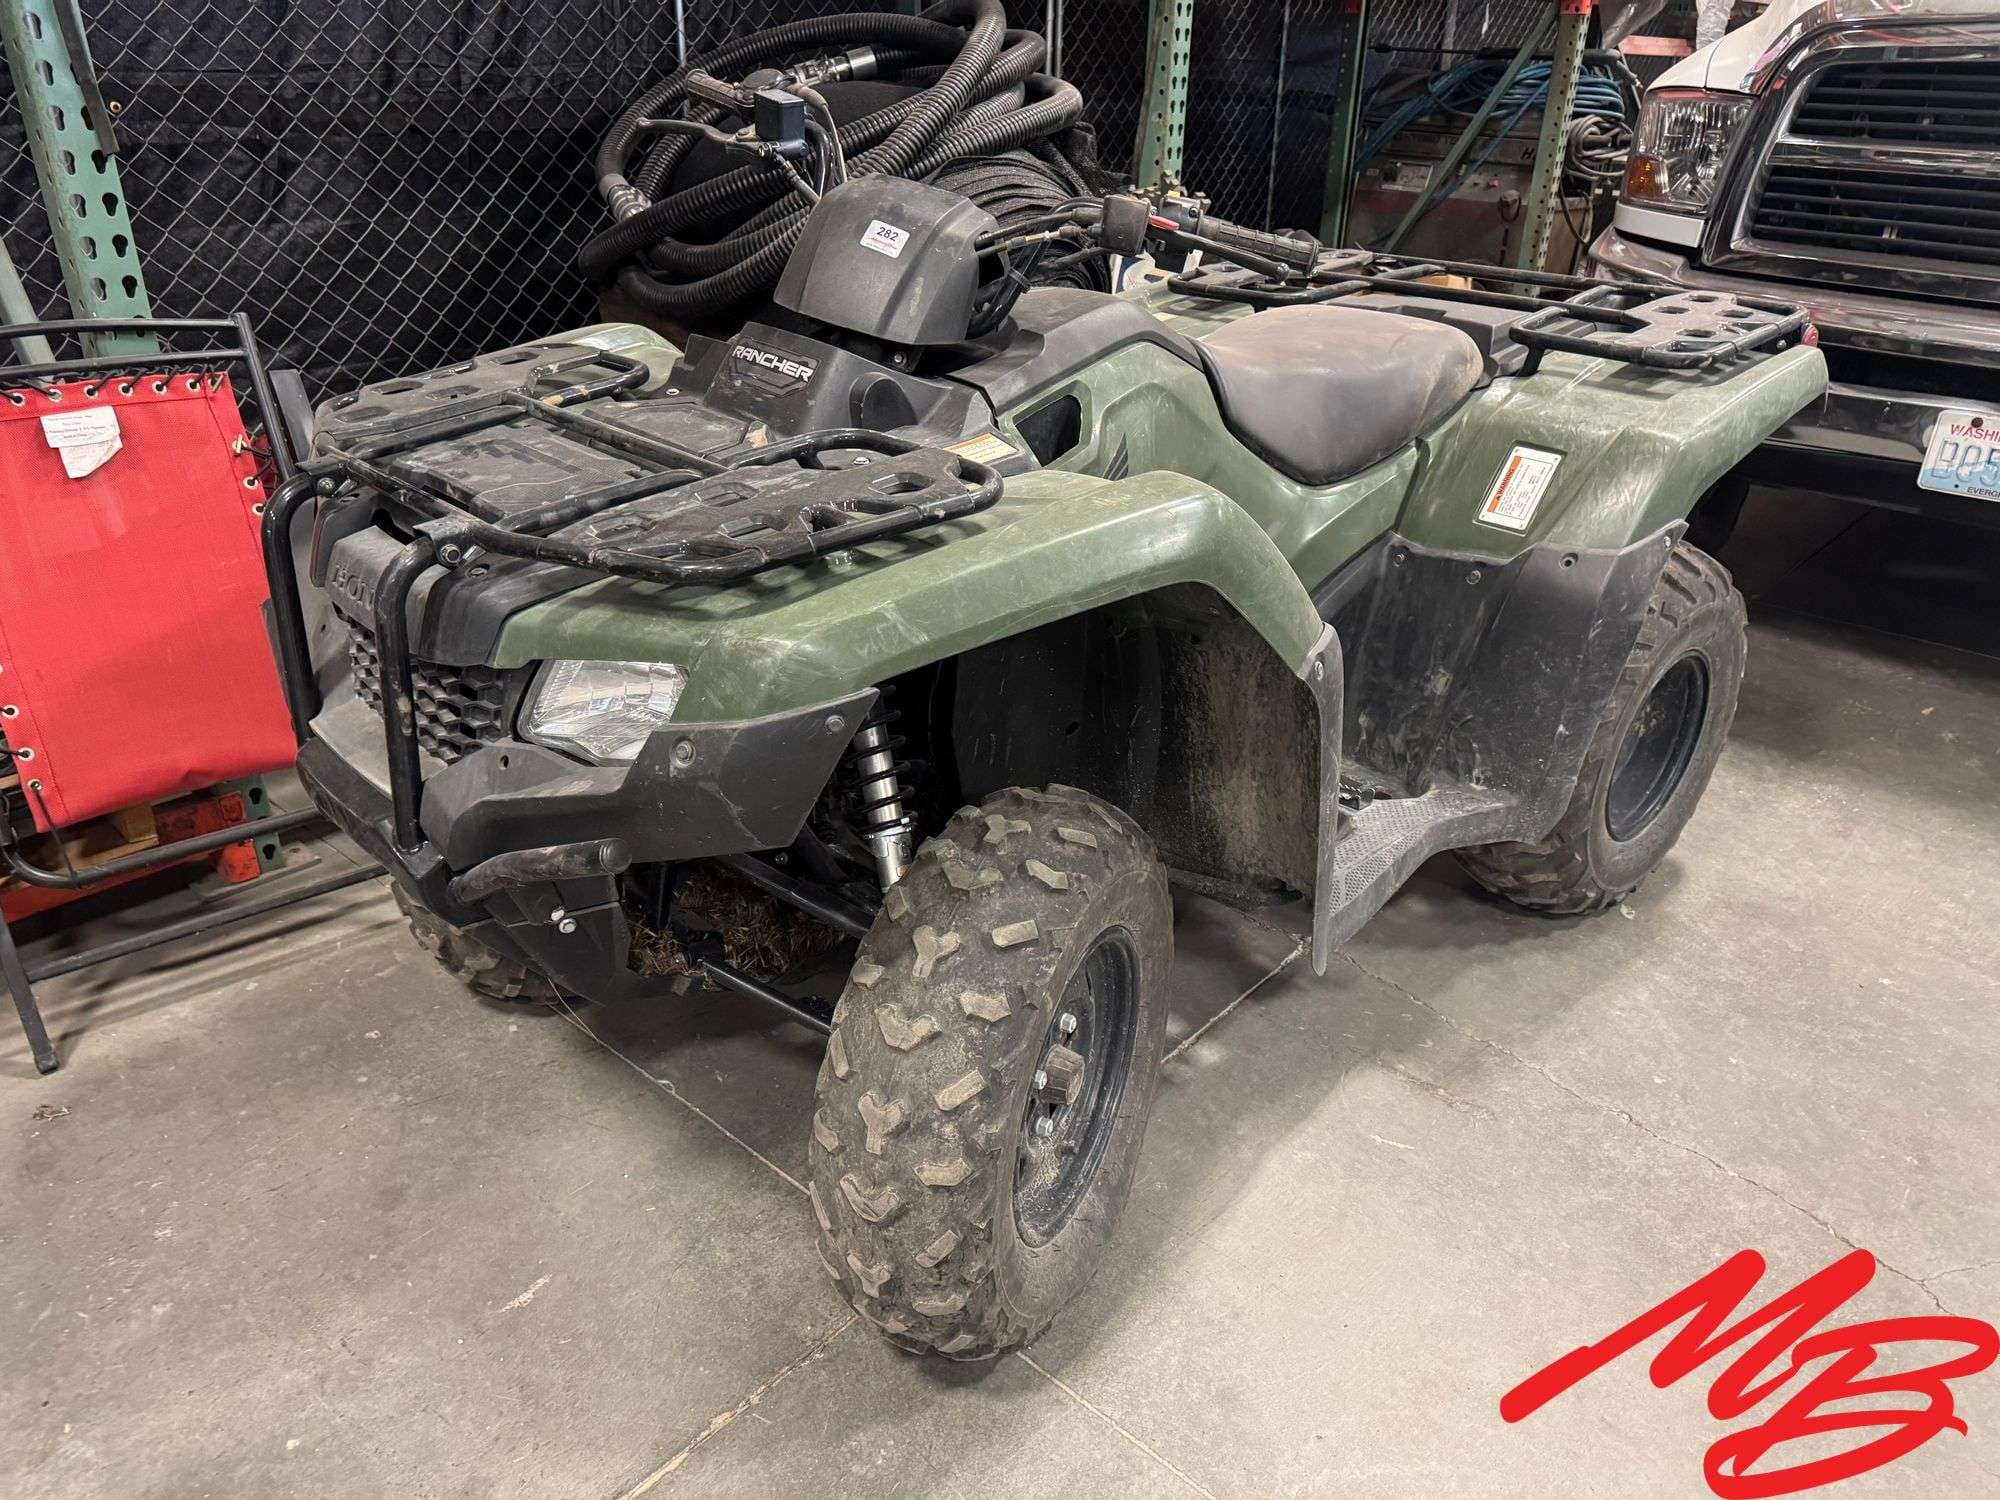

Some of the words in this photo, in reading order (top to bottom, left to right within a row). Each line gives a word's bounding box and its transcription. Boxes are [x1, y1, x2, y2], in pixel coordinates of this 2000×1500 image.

[877, 226, 899, 242] 282
[732, 345, 814, 383] RANCHER
[333, 562, 376, 611] HON
